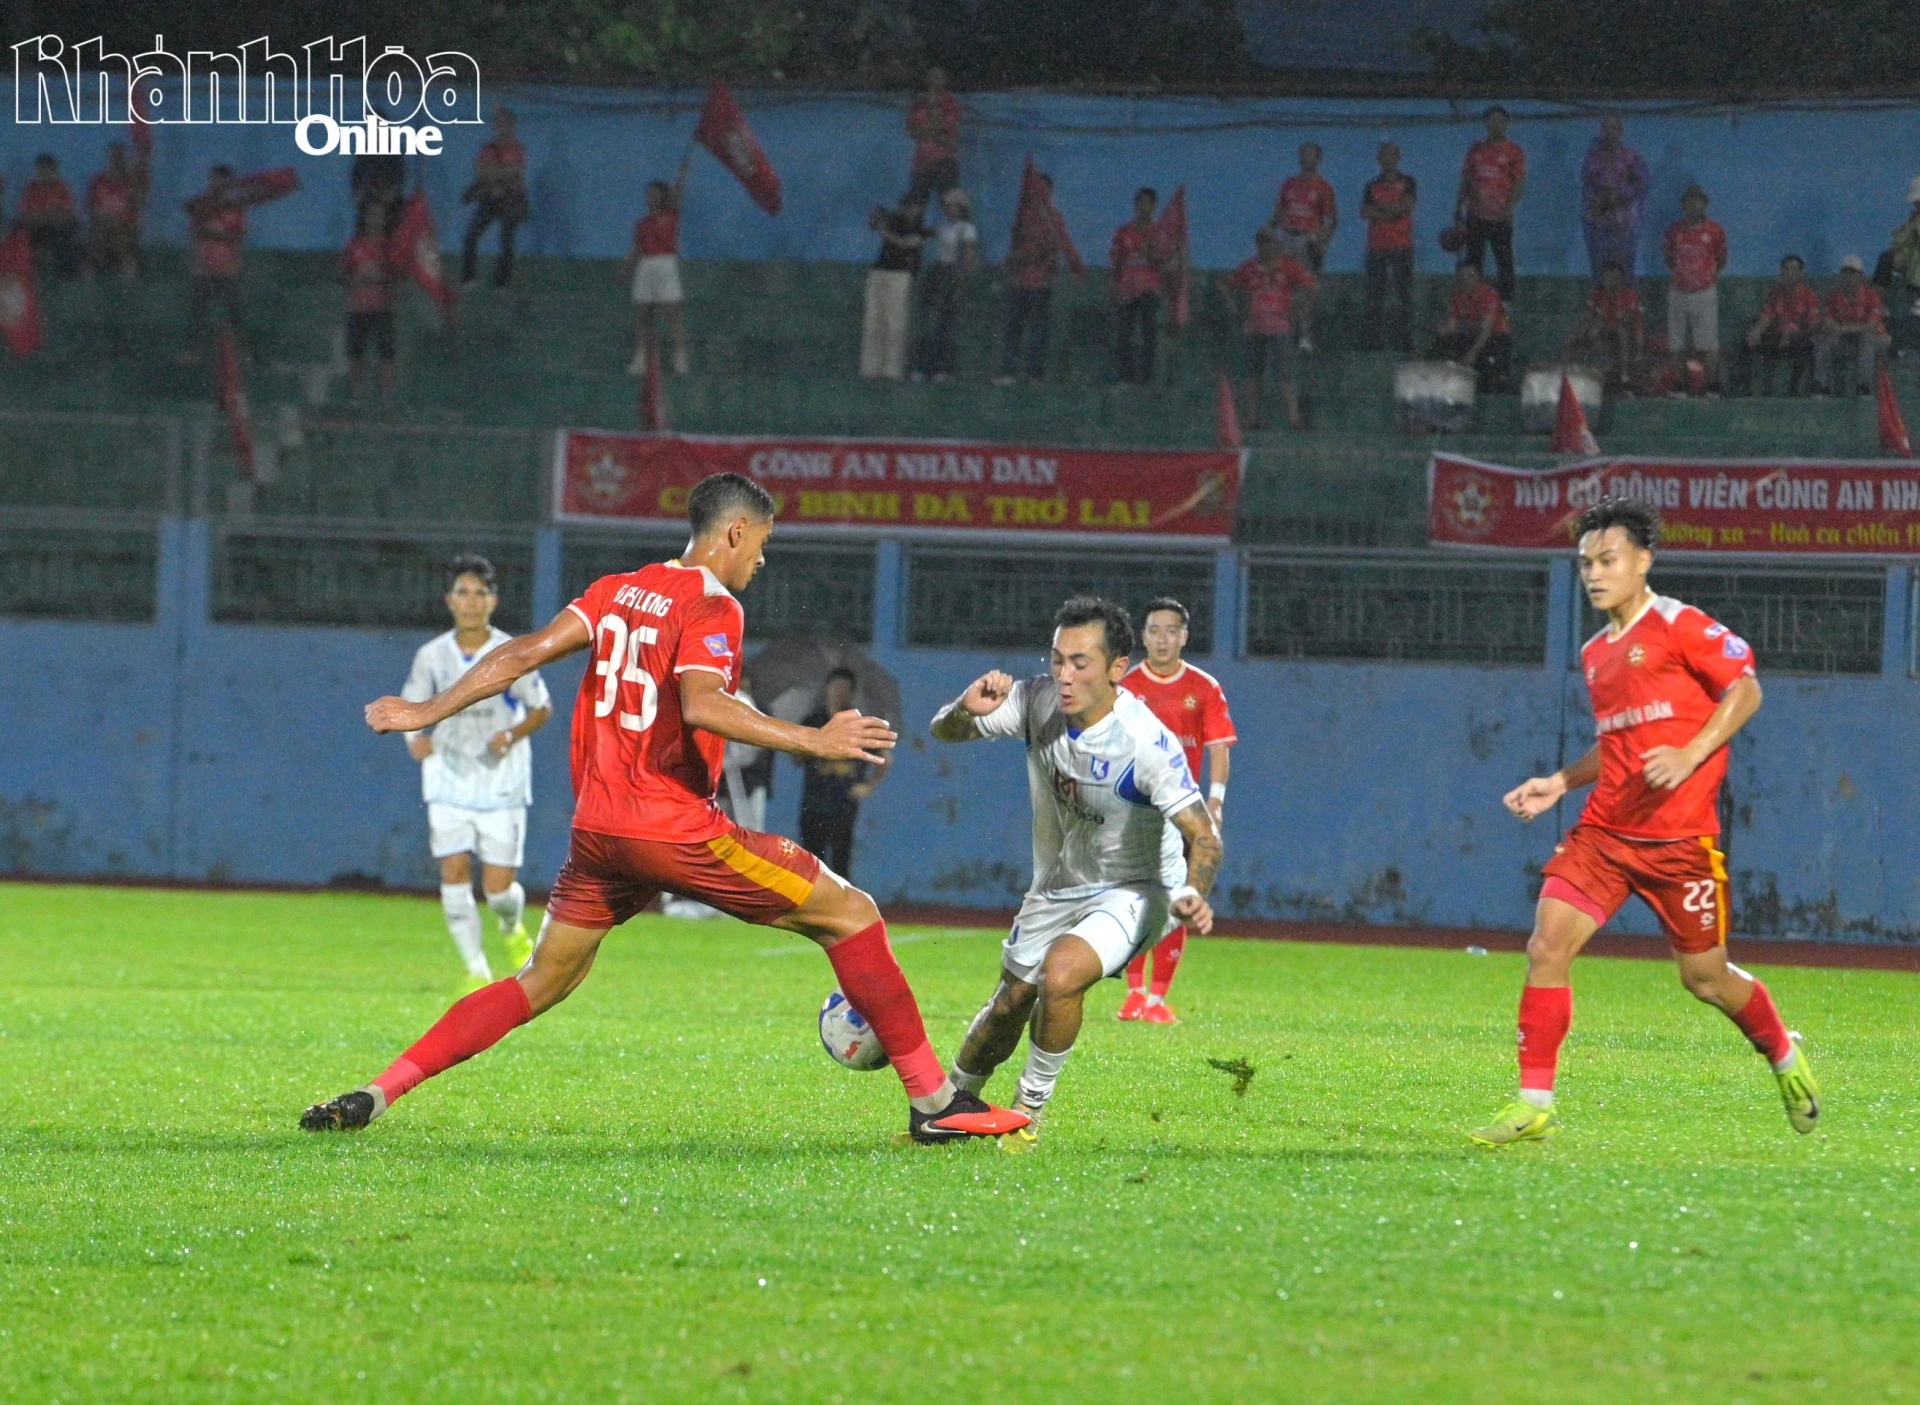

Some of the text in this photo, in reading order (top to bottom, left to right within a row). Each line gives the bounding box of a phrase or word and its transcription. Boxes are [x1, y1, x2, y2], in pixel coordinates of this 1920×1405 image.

[750, 449, 832, 480] CÔNG
[842, 452, 888, 481] AN
[1688, 472, 1747, 509] VIÊN
[1755, 471, 1829, 510] CÔNG
[1836, 480, 1874, 511] AN
[595, 613, 659, 732] 35
[1682, 879, 1716, 912] 22
